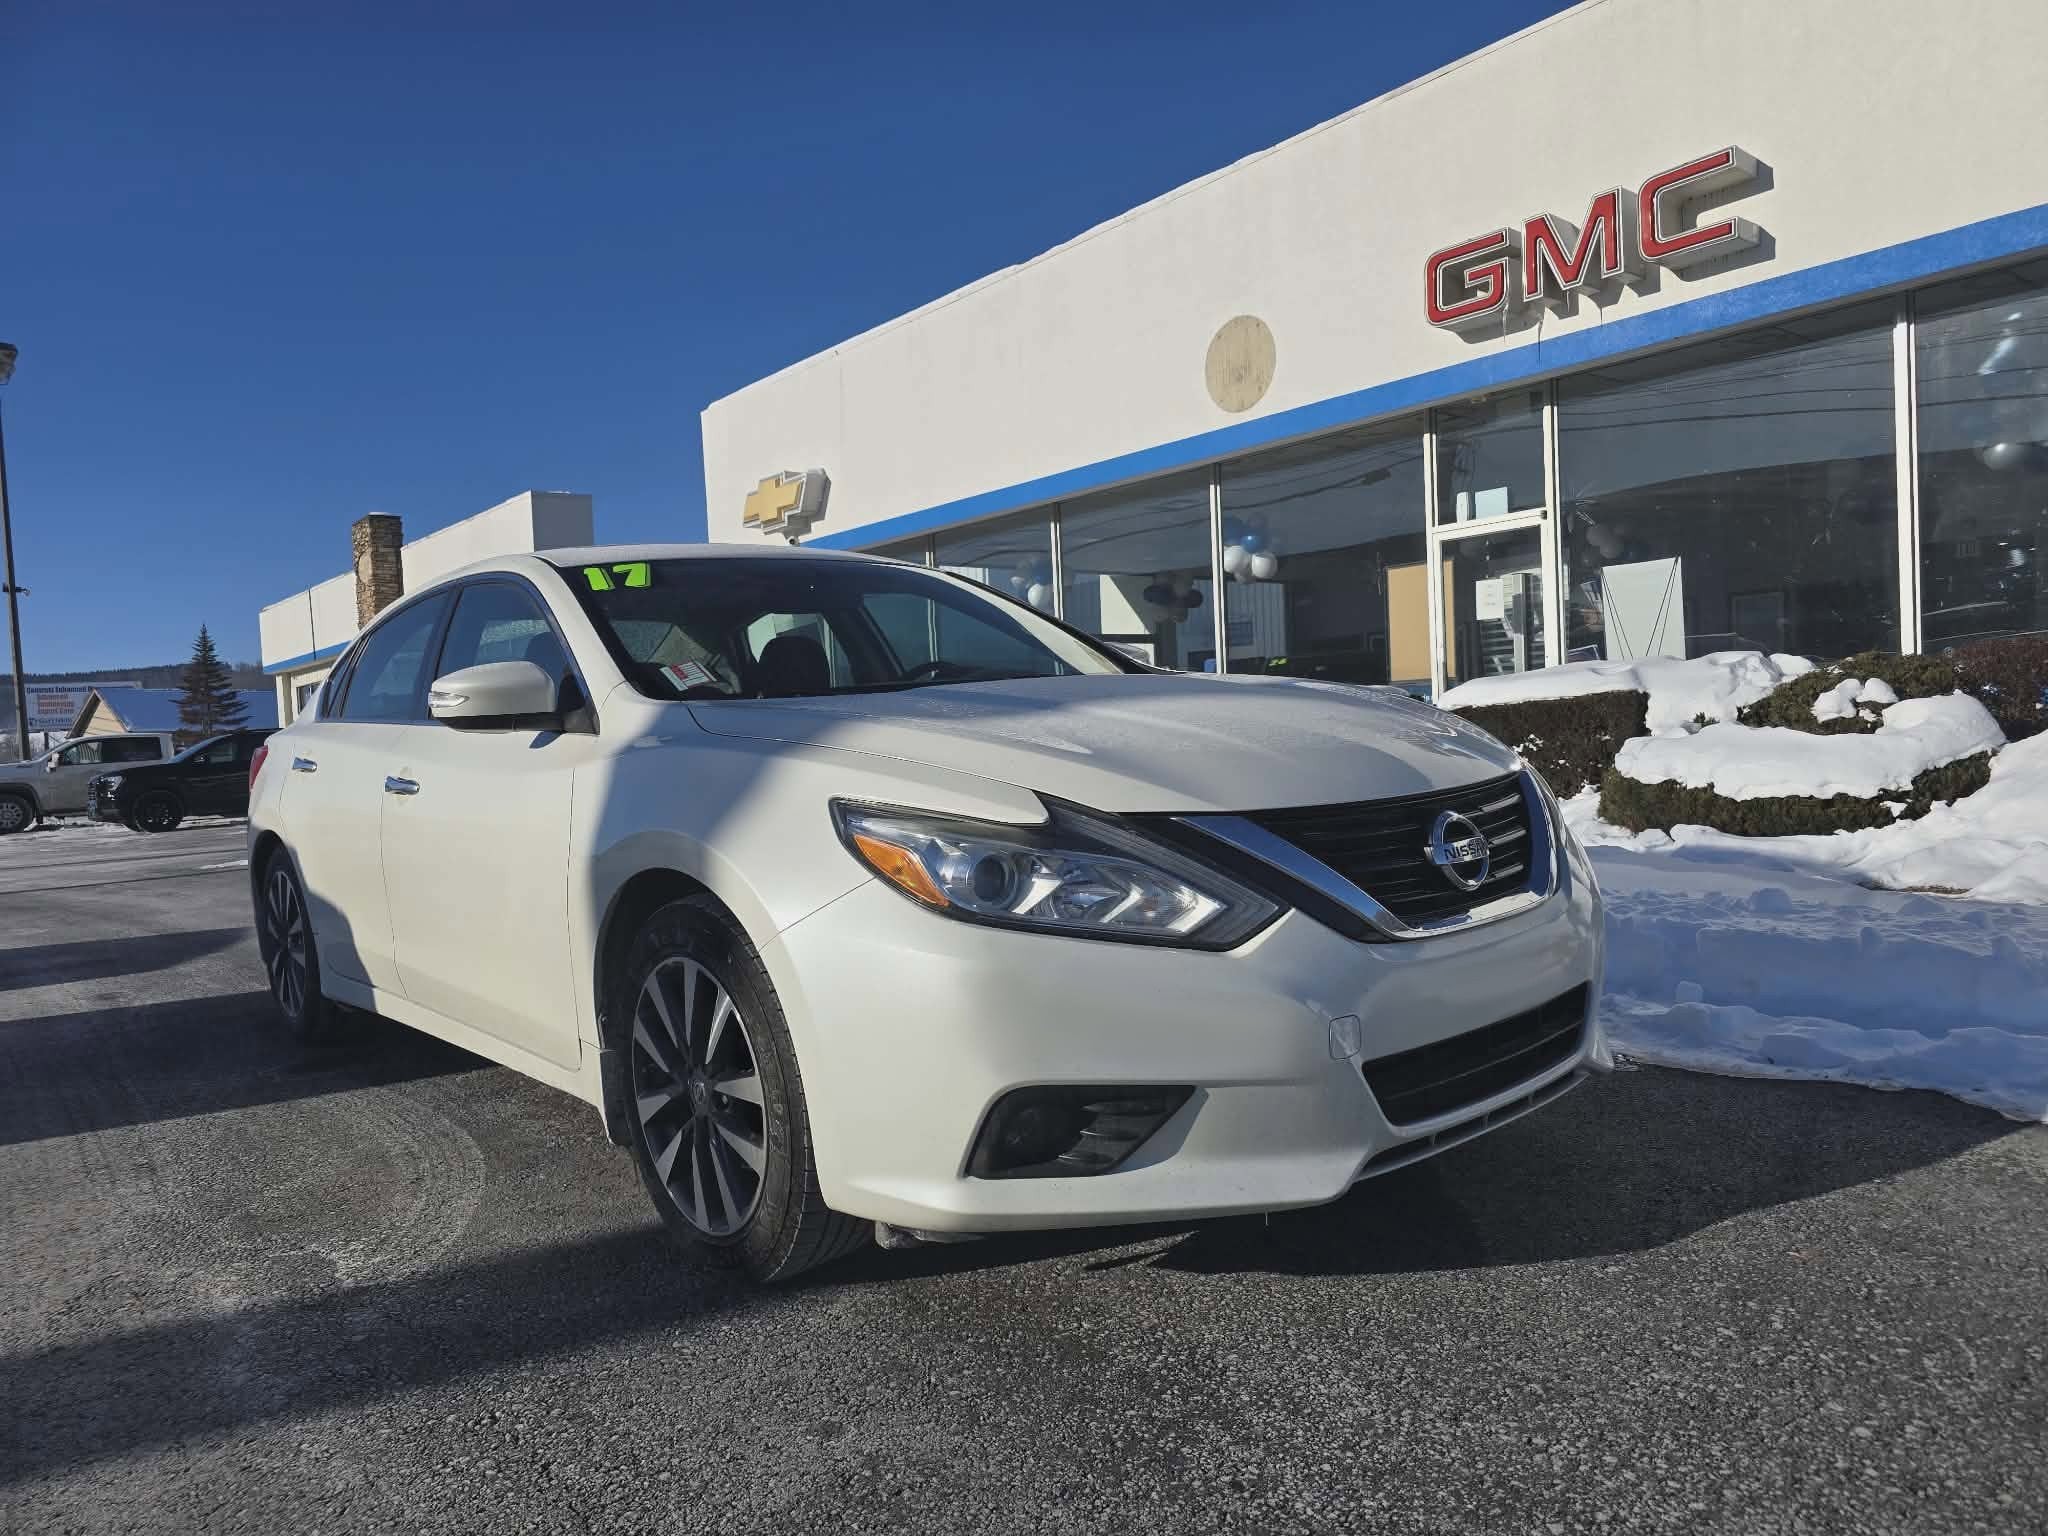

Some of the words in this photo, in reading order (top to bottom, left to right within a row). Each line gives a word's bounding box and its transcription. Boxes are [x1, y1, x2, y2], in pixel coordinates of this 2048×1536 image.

[1425, 145, 1740, 328] GMC
[583, 562, 651, 591] 17
[1444, 838, 1488, 860] NISSAN
